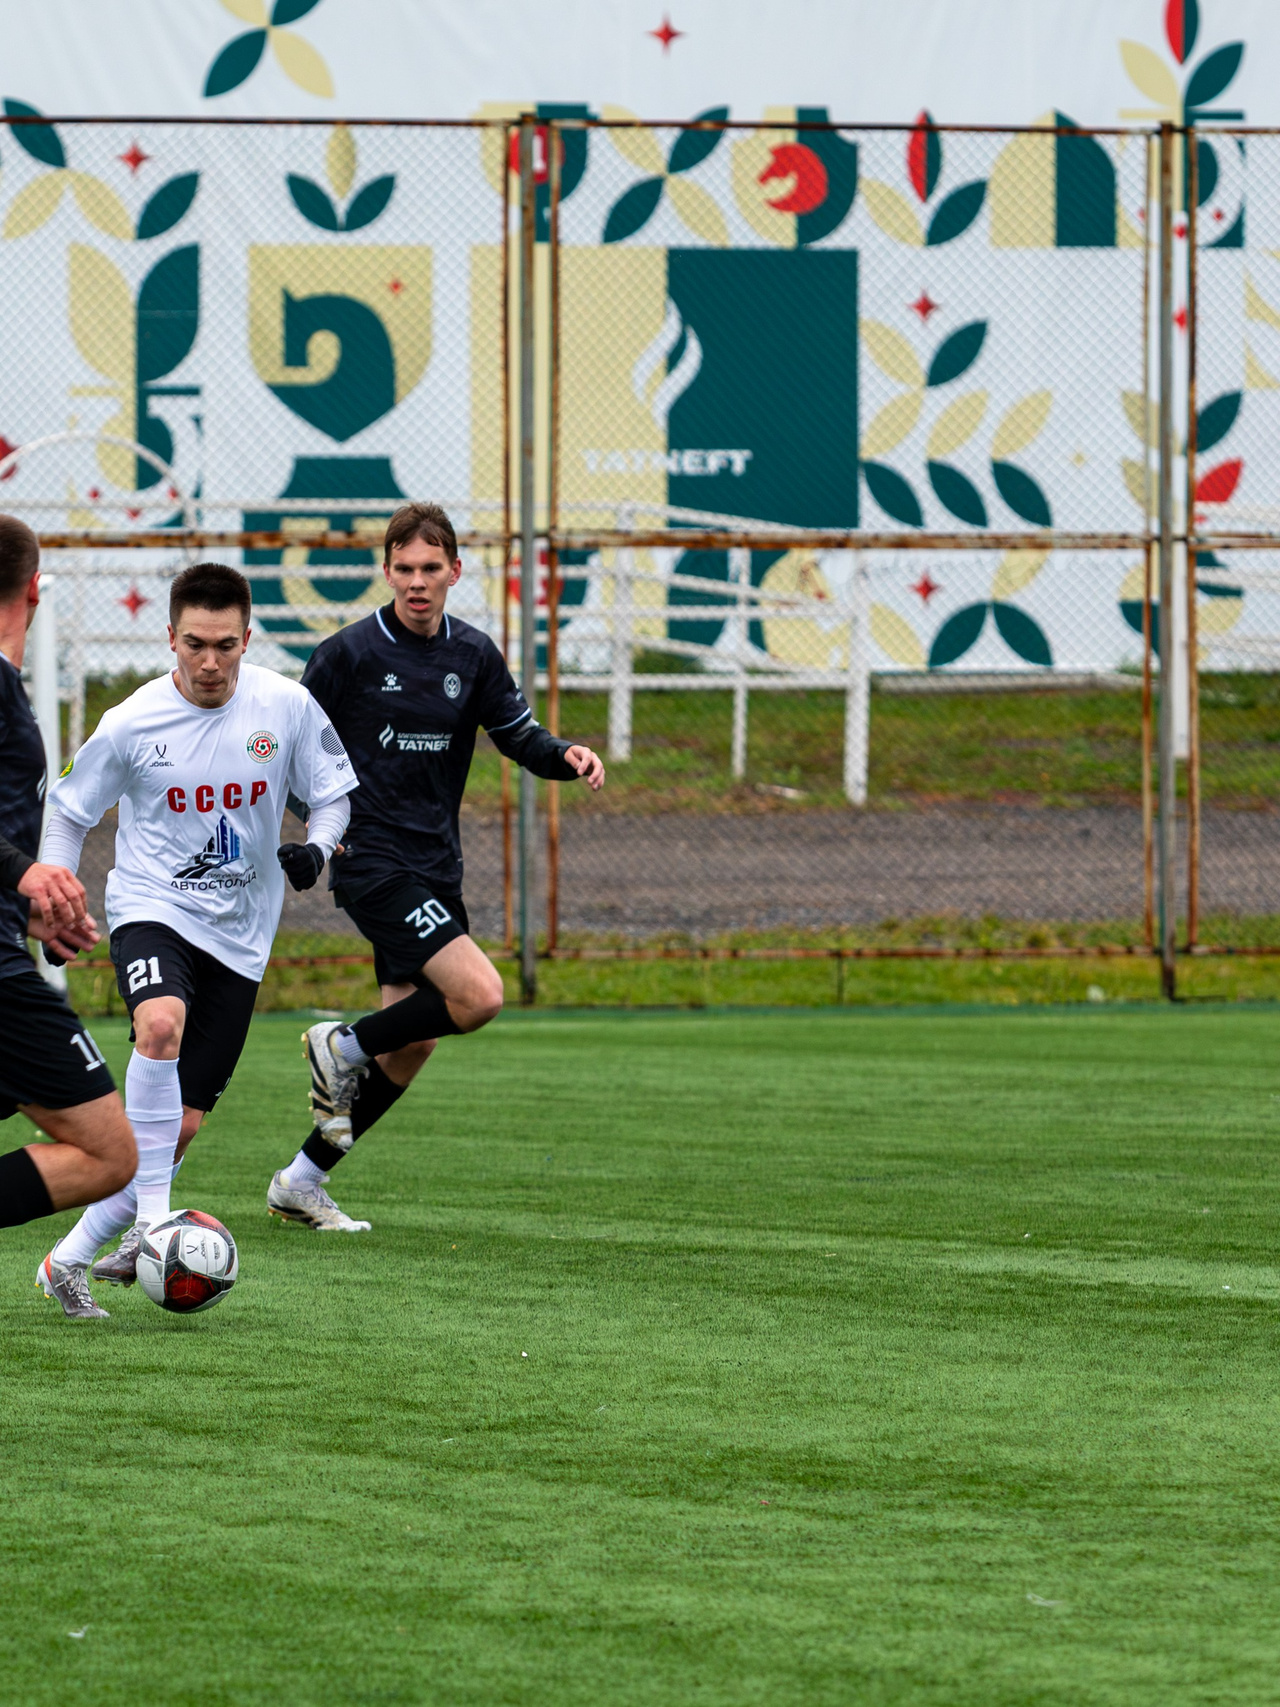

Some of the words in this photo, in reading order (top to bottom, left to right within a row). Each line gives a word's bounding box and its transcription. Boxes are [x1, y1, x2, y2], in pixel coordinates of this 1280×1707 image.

[582, 448, 754, 477] TATNEFT
[149, 760, 175, 768] JÖGEL
[167, 780, 267, 813] СССР
[170, 871, 257, 891] АВТОСТОЛЦА
[404, 898, 452, 939] 30
[126, 956, 163, 995] 21
